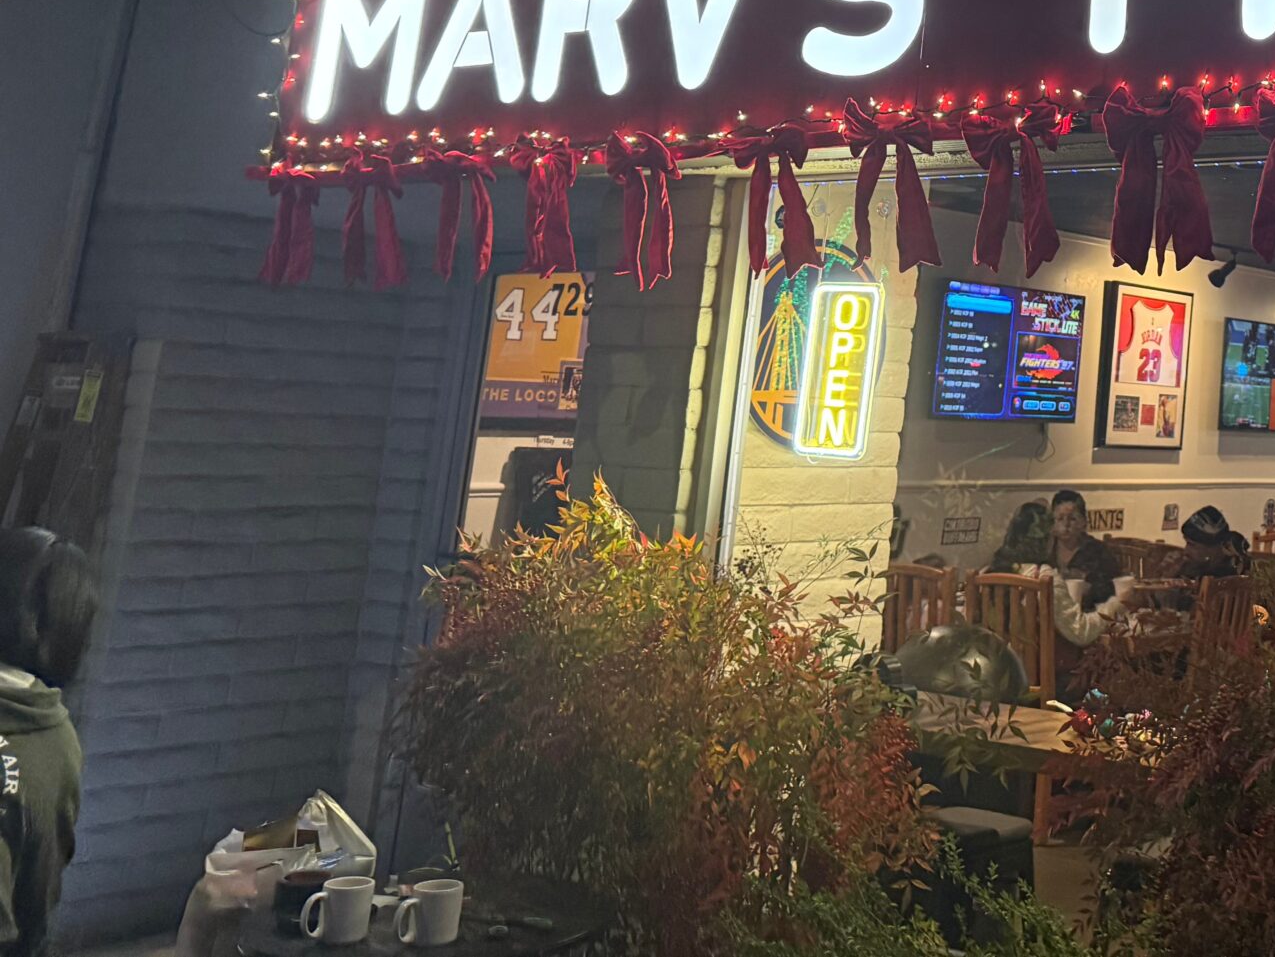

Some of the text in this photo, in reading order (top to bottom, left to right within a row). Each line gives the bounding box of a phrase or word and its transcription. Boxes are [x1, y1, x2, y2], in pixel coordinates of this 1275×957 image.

[818, 294, 859, 447] OPEN
[1019, 357, 1060, 369] FIGHTERS
[1137, 348, 1162, 382] 23
[1086, 509, 1124, 531] AINTS
[1, 754, 20, 795] AIR
